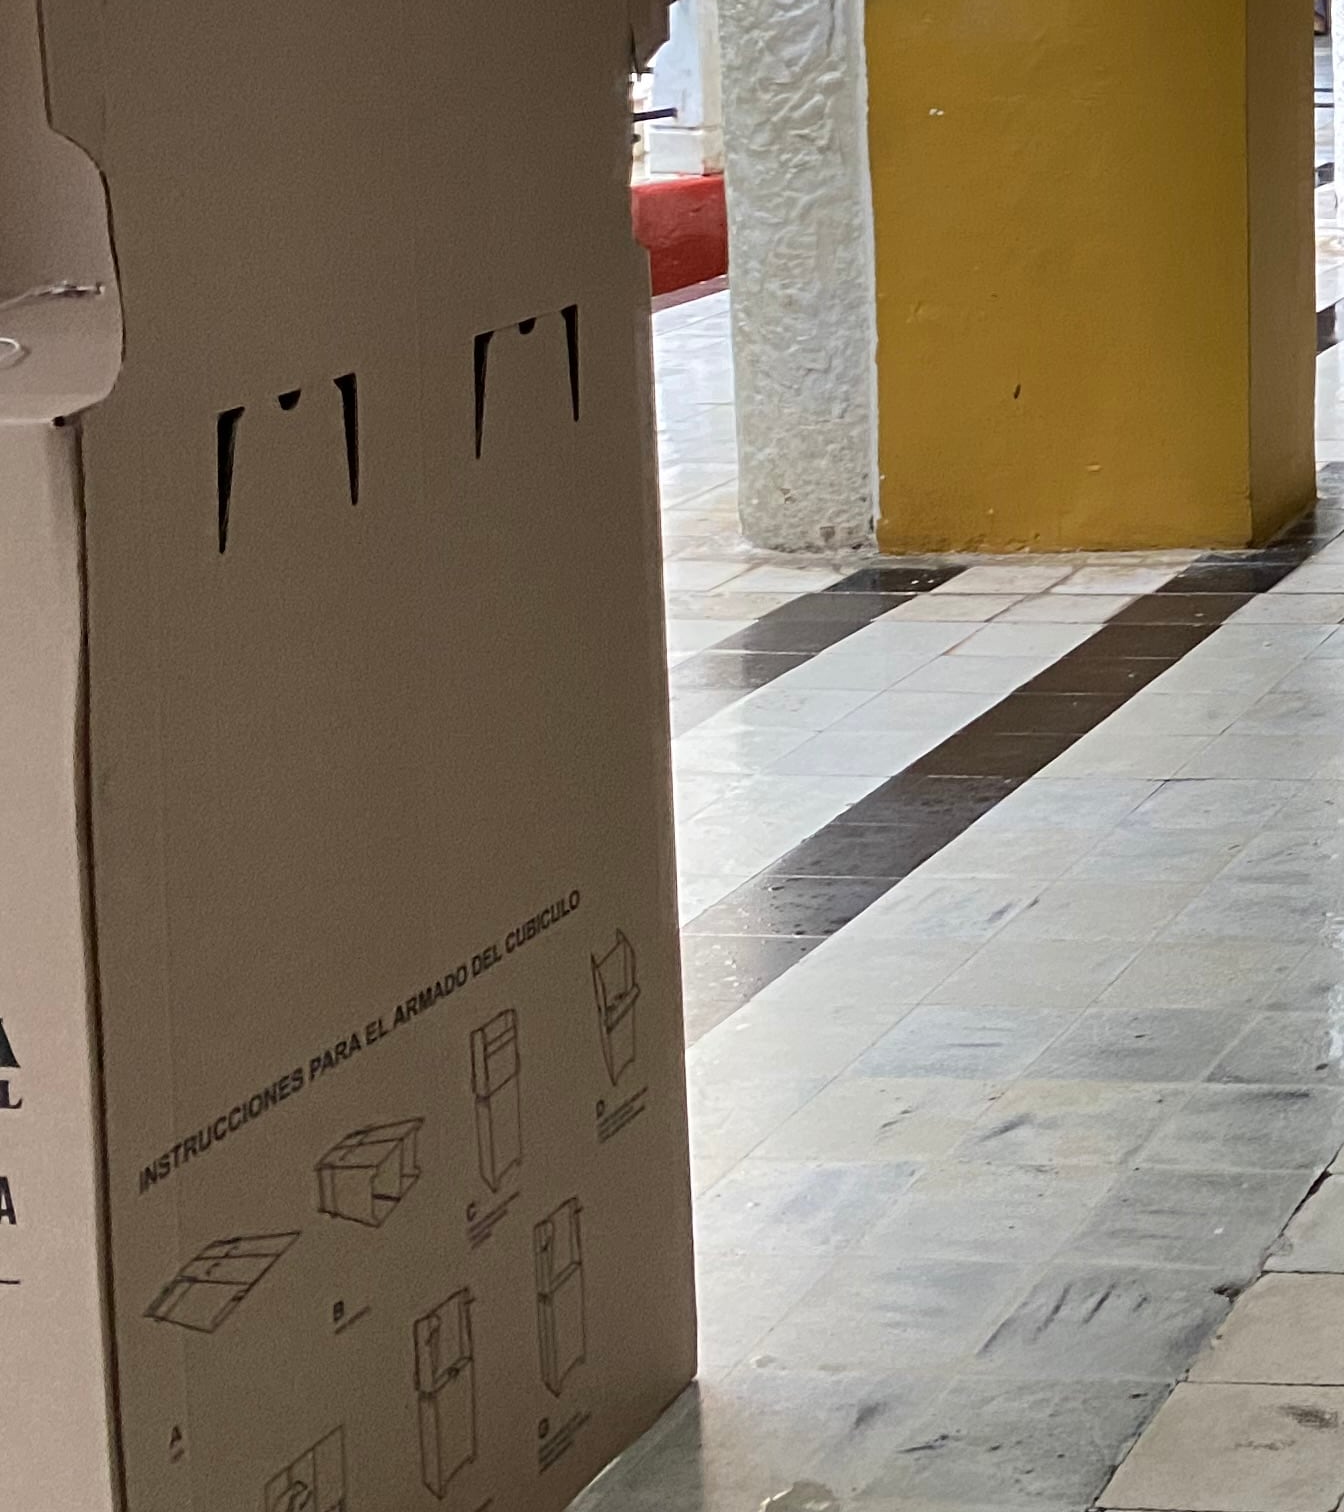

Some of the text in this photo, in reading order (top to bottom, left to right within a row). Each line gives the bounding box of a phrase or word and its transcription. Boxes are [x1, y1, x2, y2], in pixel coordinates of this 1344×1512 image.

[139, 889, 581, 1194] INSTRUCCIONES PARA EL ARMADO DEL CUBICULO
